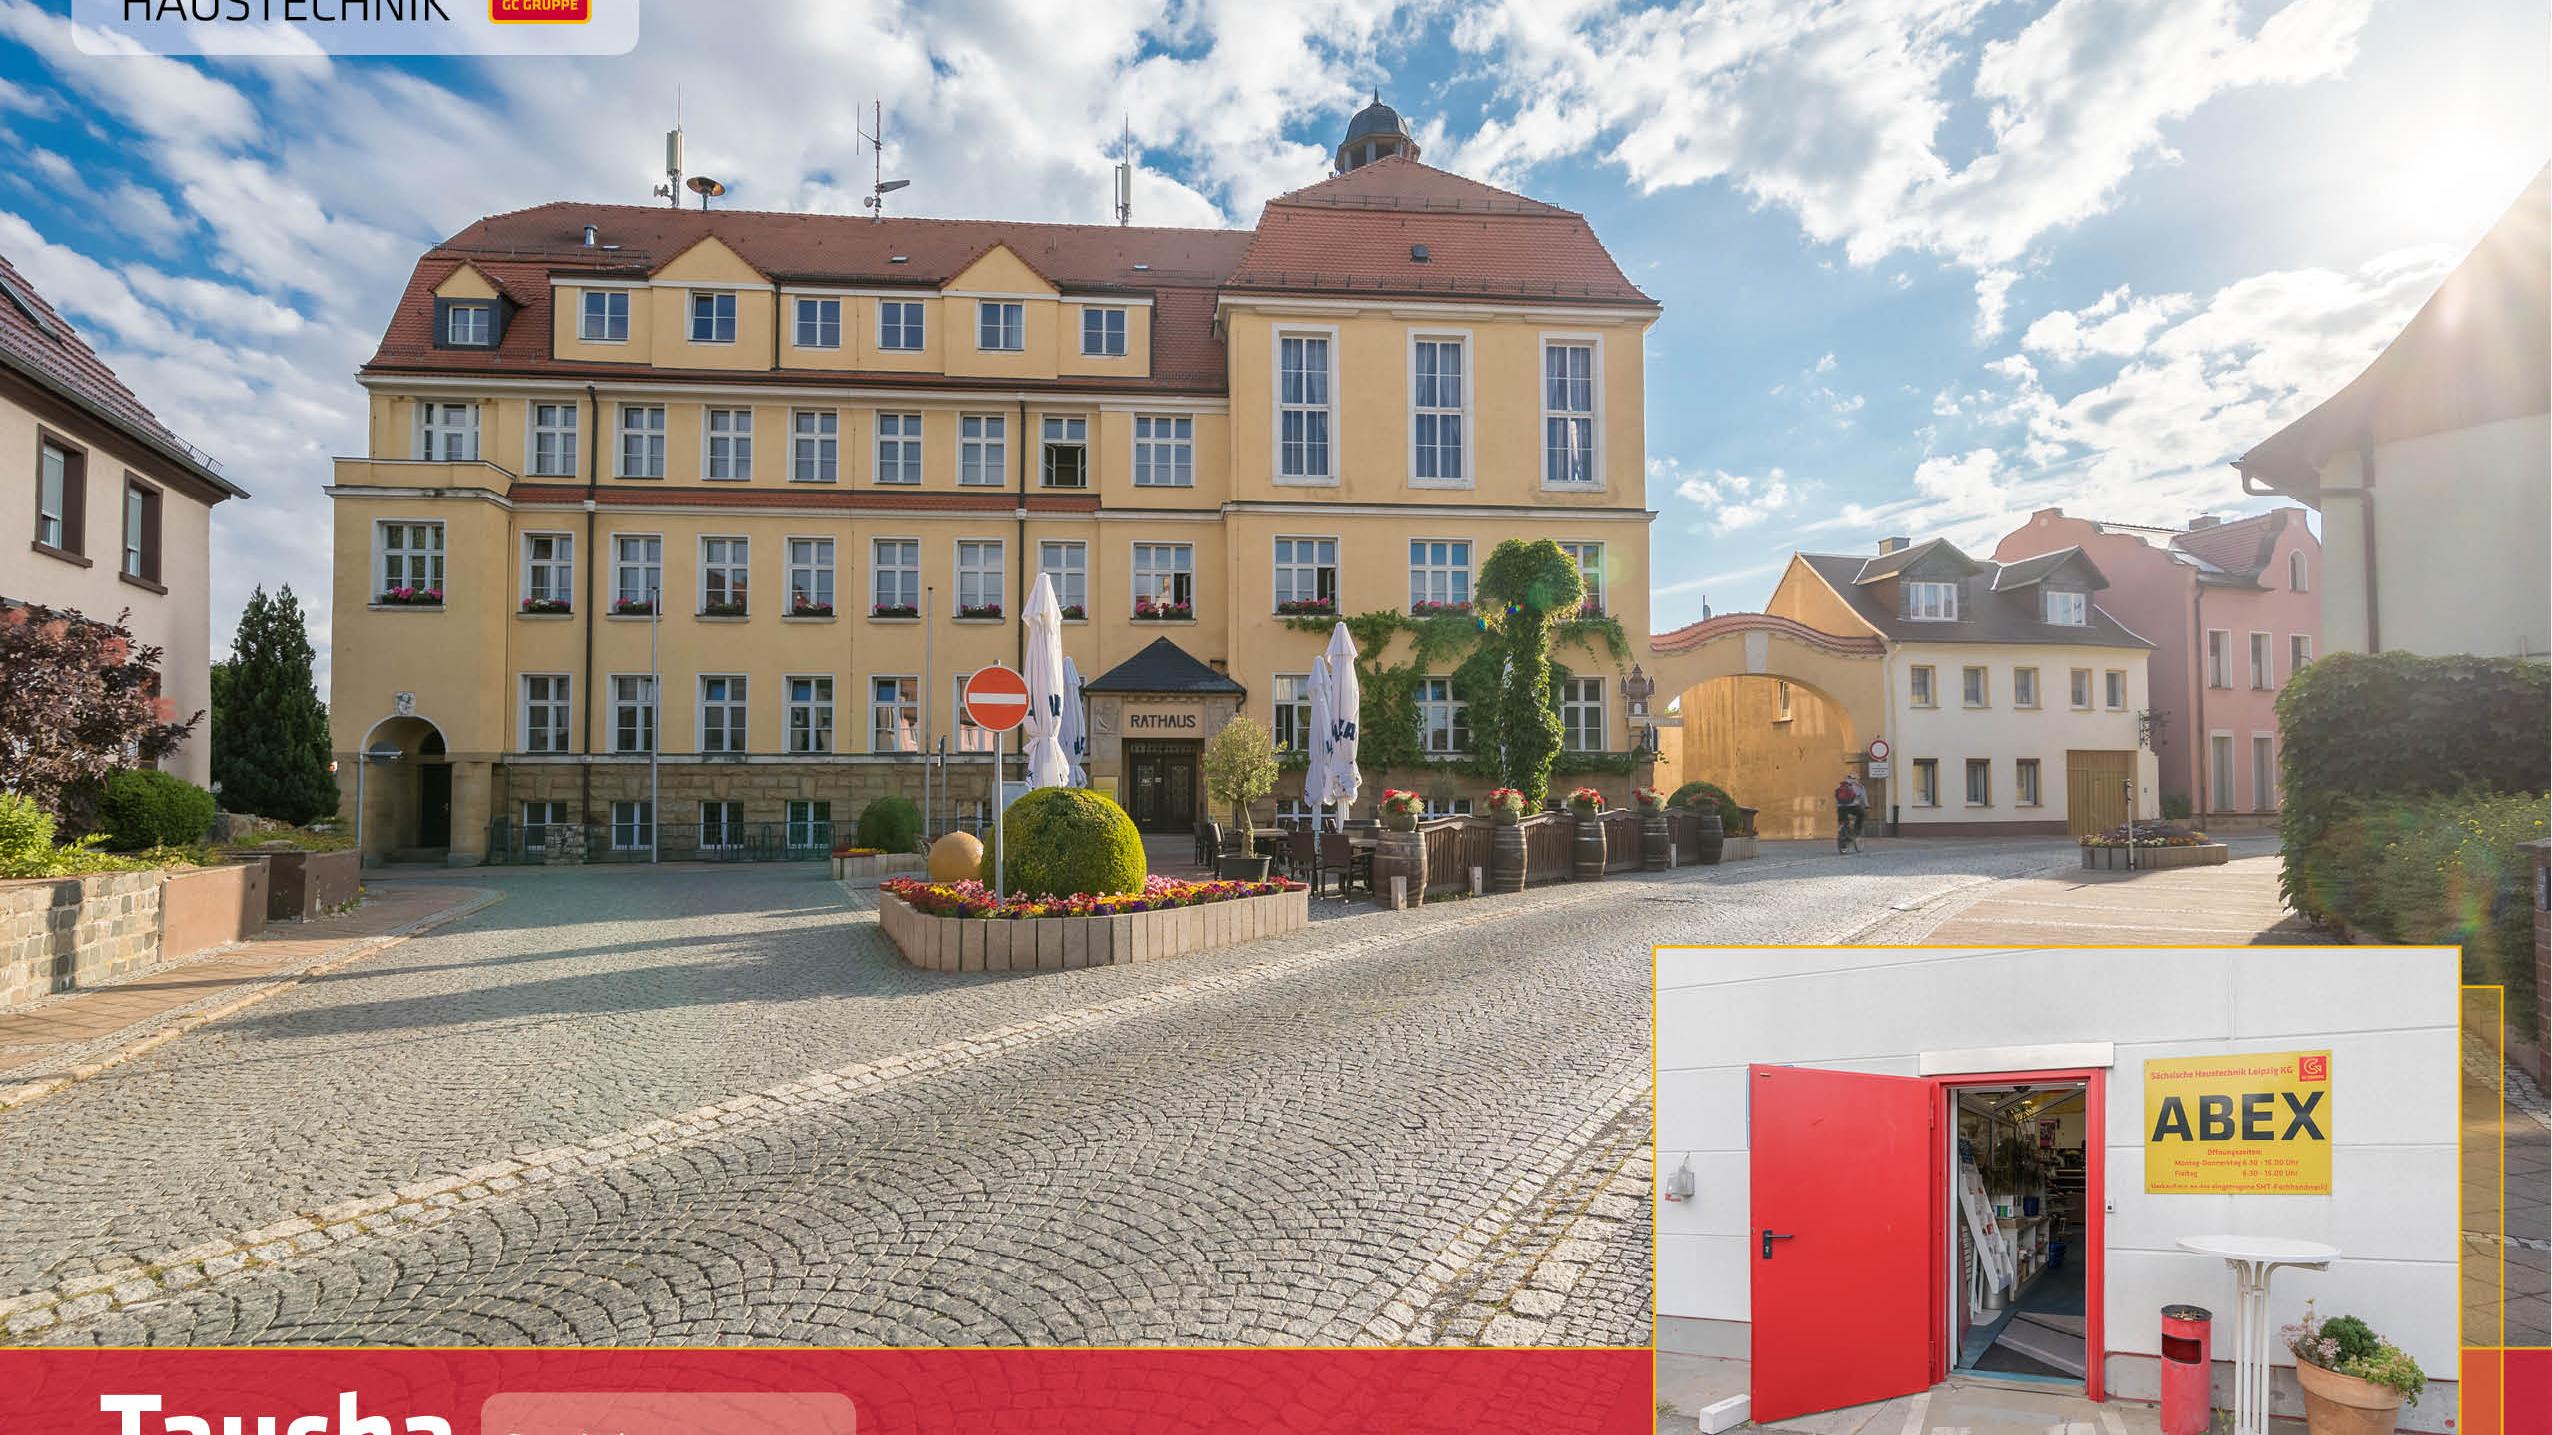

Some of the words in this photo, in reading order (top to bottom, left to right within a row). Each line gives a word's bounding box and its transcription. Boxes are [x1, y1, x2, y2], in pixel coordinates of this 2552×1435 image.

[1130, 714, 1197, 729] RATHAUS
[2195, 1068, 2246, 1078] Haustechnik
[2248, 1066, 2279, 1076] Leipzig
[2281, 1066, 2293, 1074] KG
[2151, 1091, 2325, 1142] ABEX
[2175, 1170, 2198, 1178] Freitag
